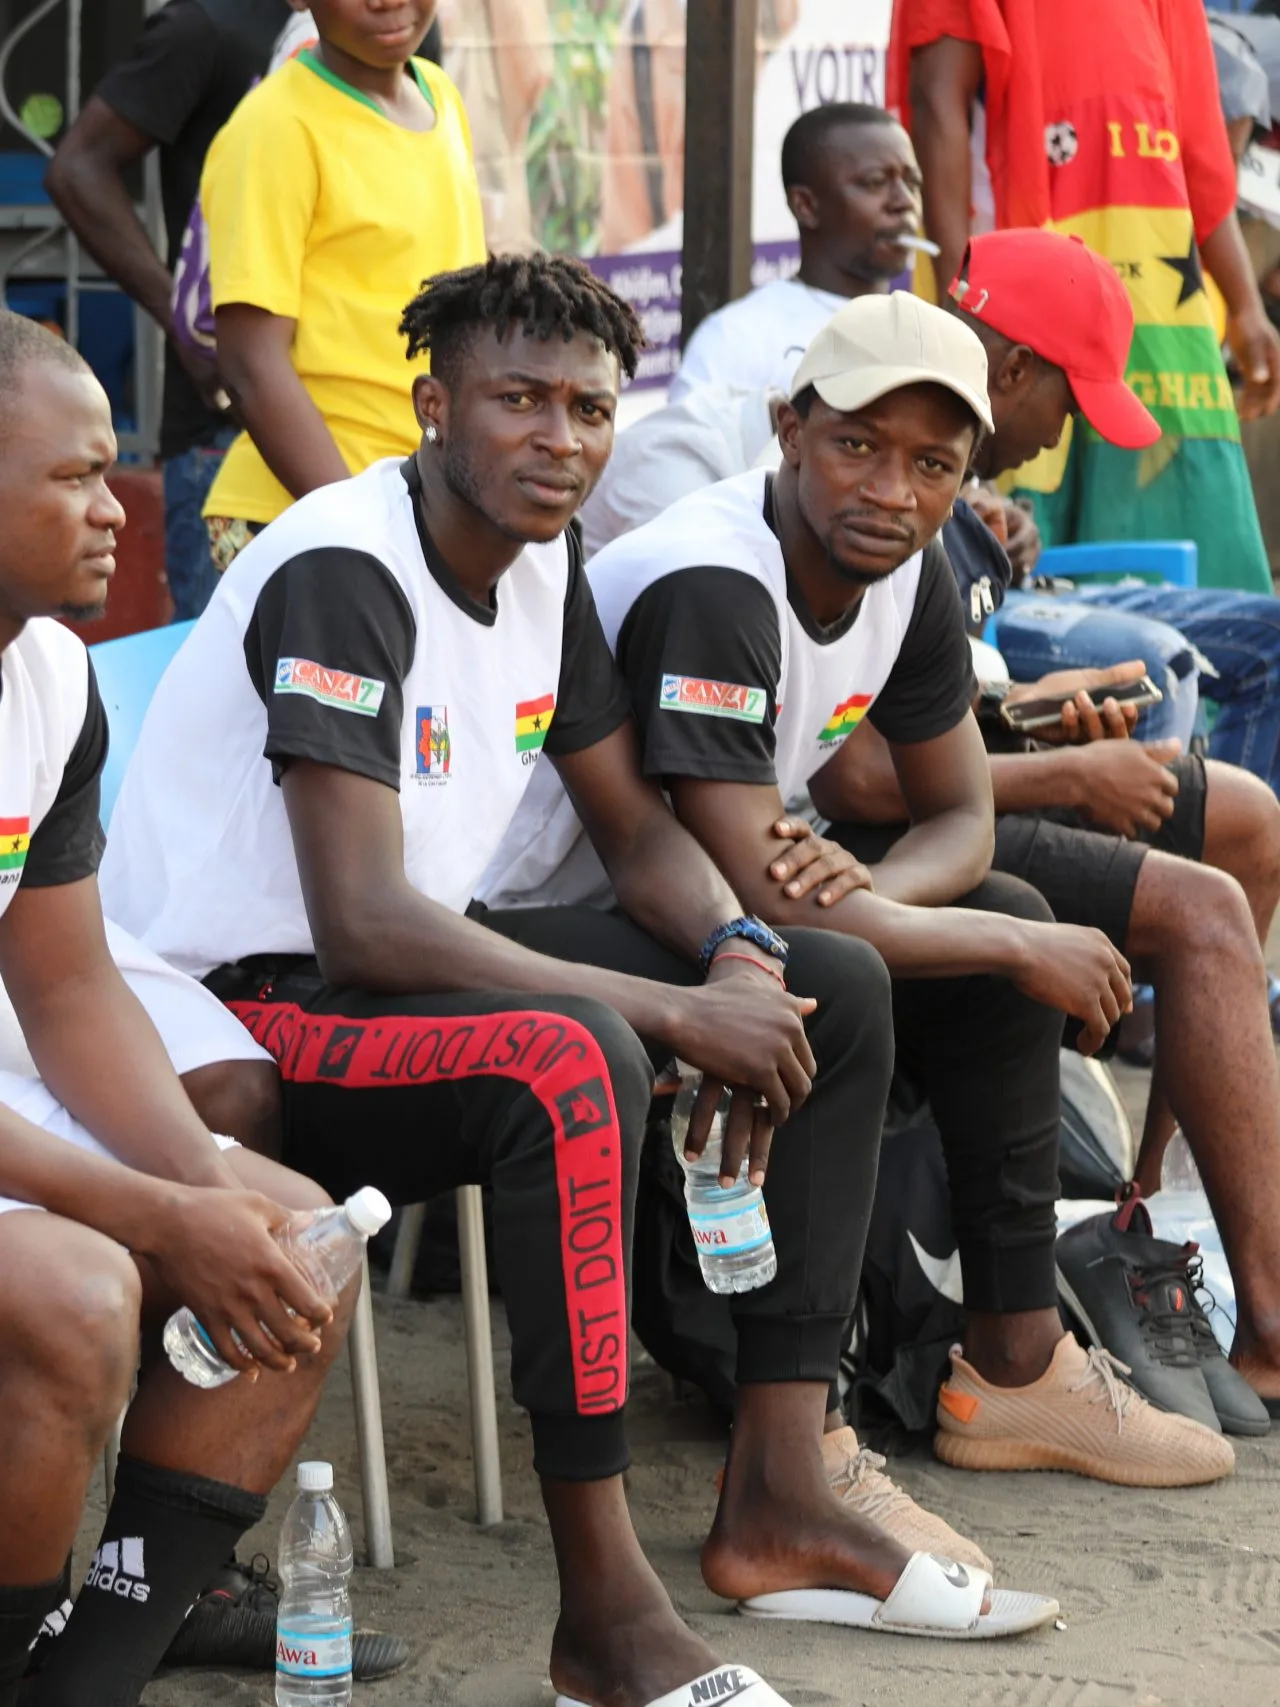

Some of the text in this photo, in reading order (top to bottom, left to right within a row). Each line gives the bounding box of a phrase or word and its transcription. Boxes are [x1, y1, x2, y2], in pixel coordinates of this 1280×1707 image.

[790, 44, 885, 112] VOTR
[1107, 121, 1125, 157] I
[468, 1018, 587, 1075] JUST
[578, 1309, 620, 1411] JUST
[85, 1562, 151, 1603] didas
[276, 1640, 318, 1666] Awa
[690, 1668, 748, 1704] NIKE
